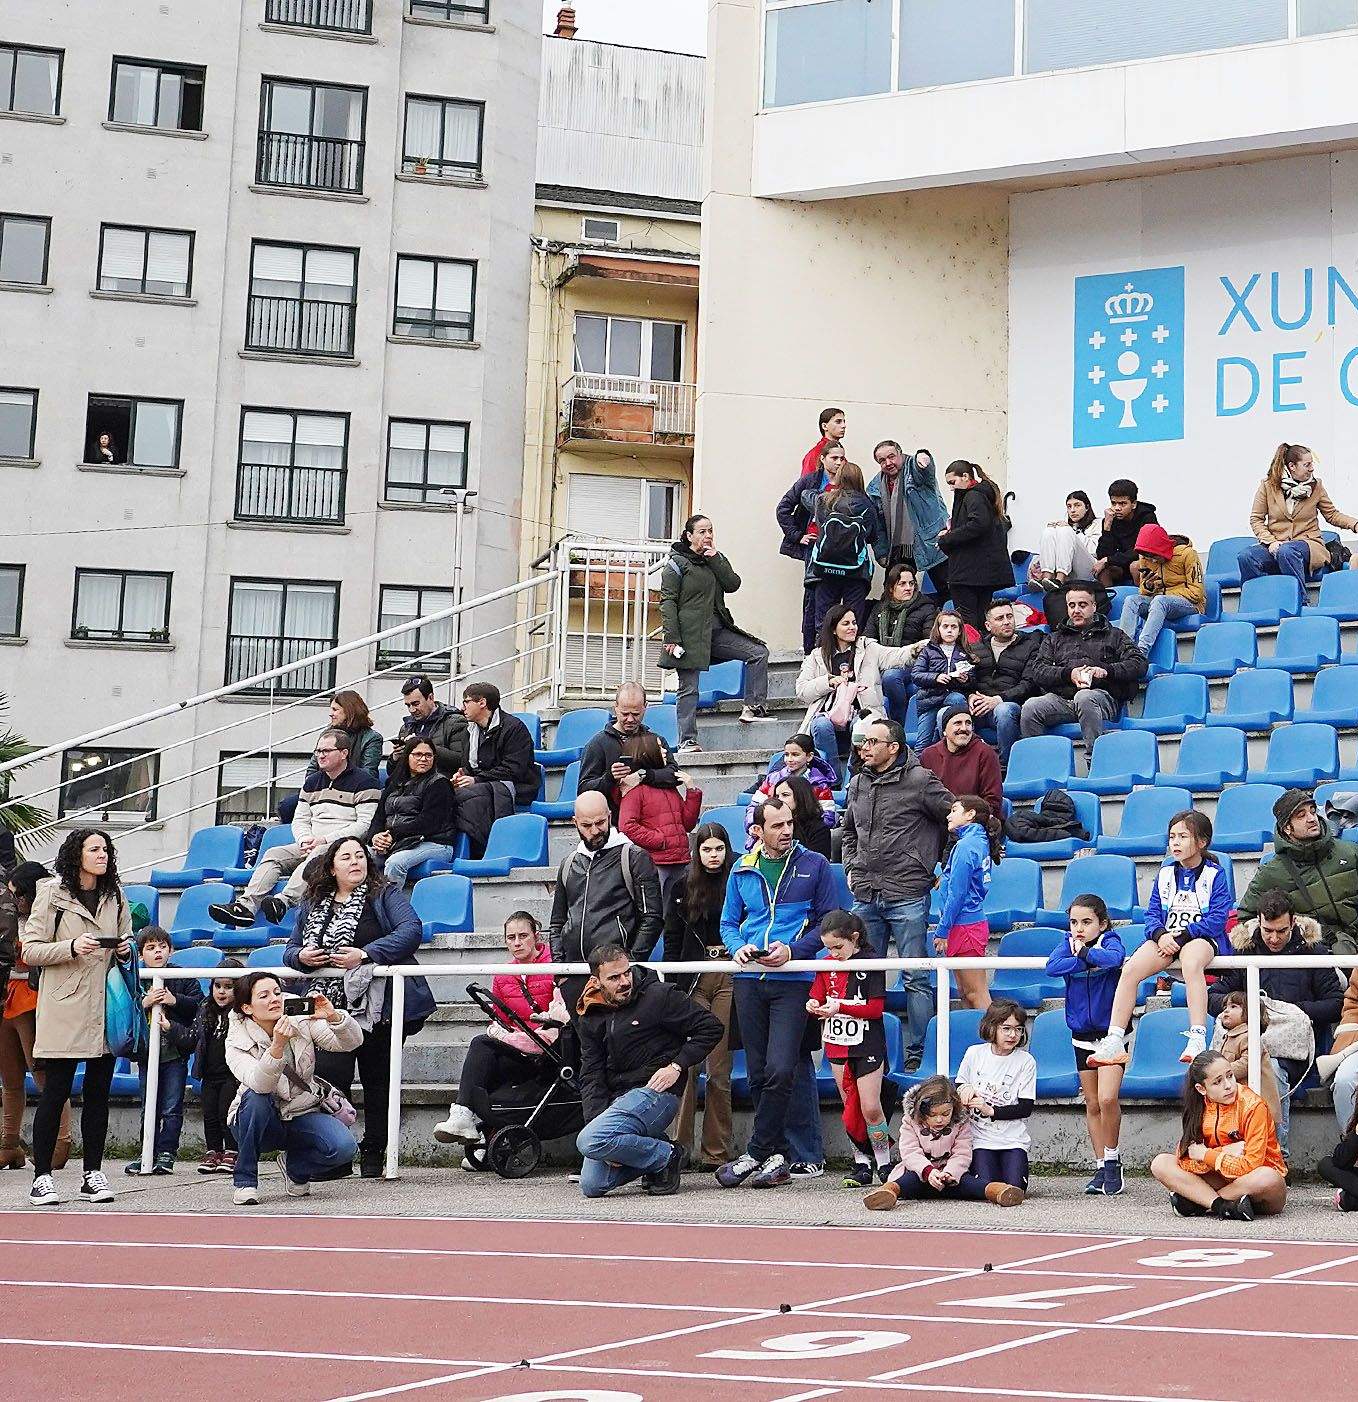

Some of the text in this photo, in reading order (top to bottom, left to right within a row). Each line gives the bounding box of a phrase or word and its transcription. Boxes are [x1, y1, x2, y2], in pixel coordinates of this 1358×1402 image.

[1216, 350, 1307, 417] DE
[828, 1018, 859, 1037] 180
[1136, 1248, 1274, 1268] 8
[936, 1283, 1137, 1310] 7
